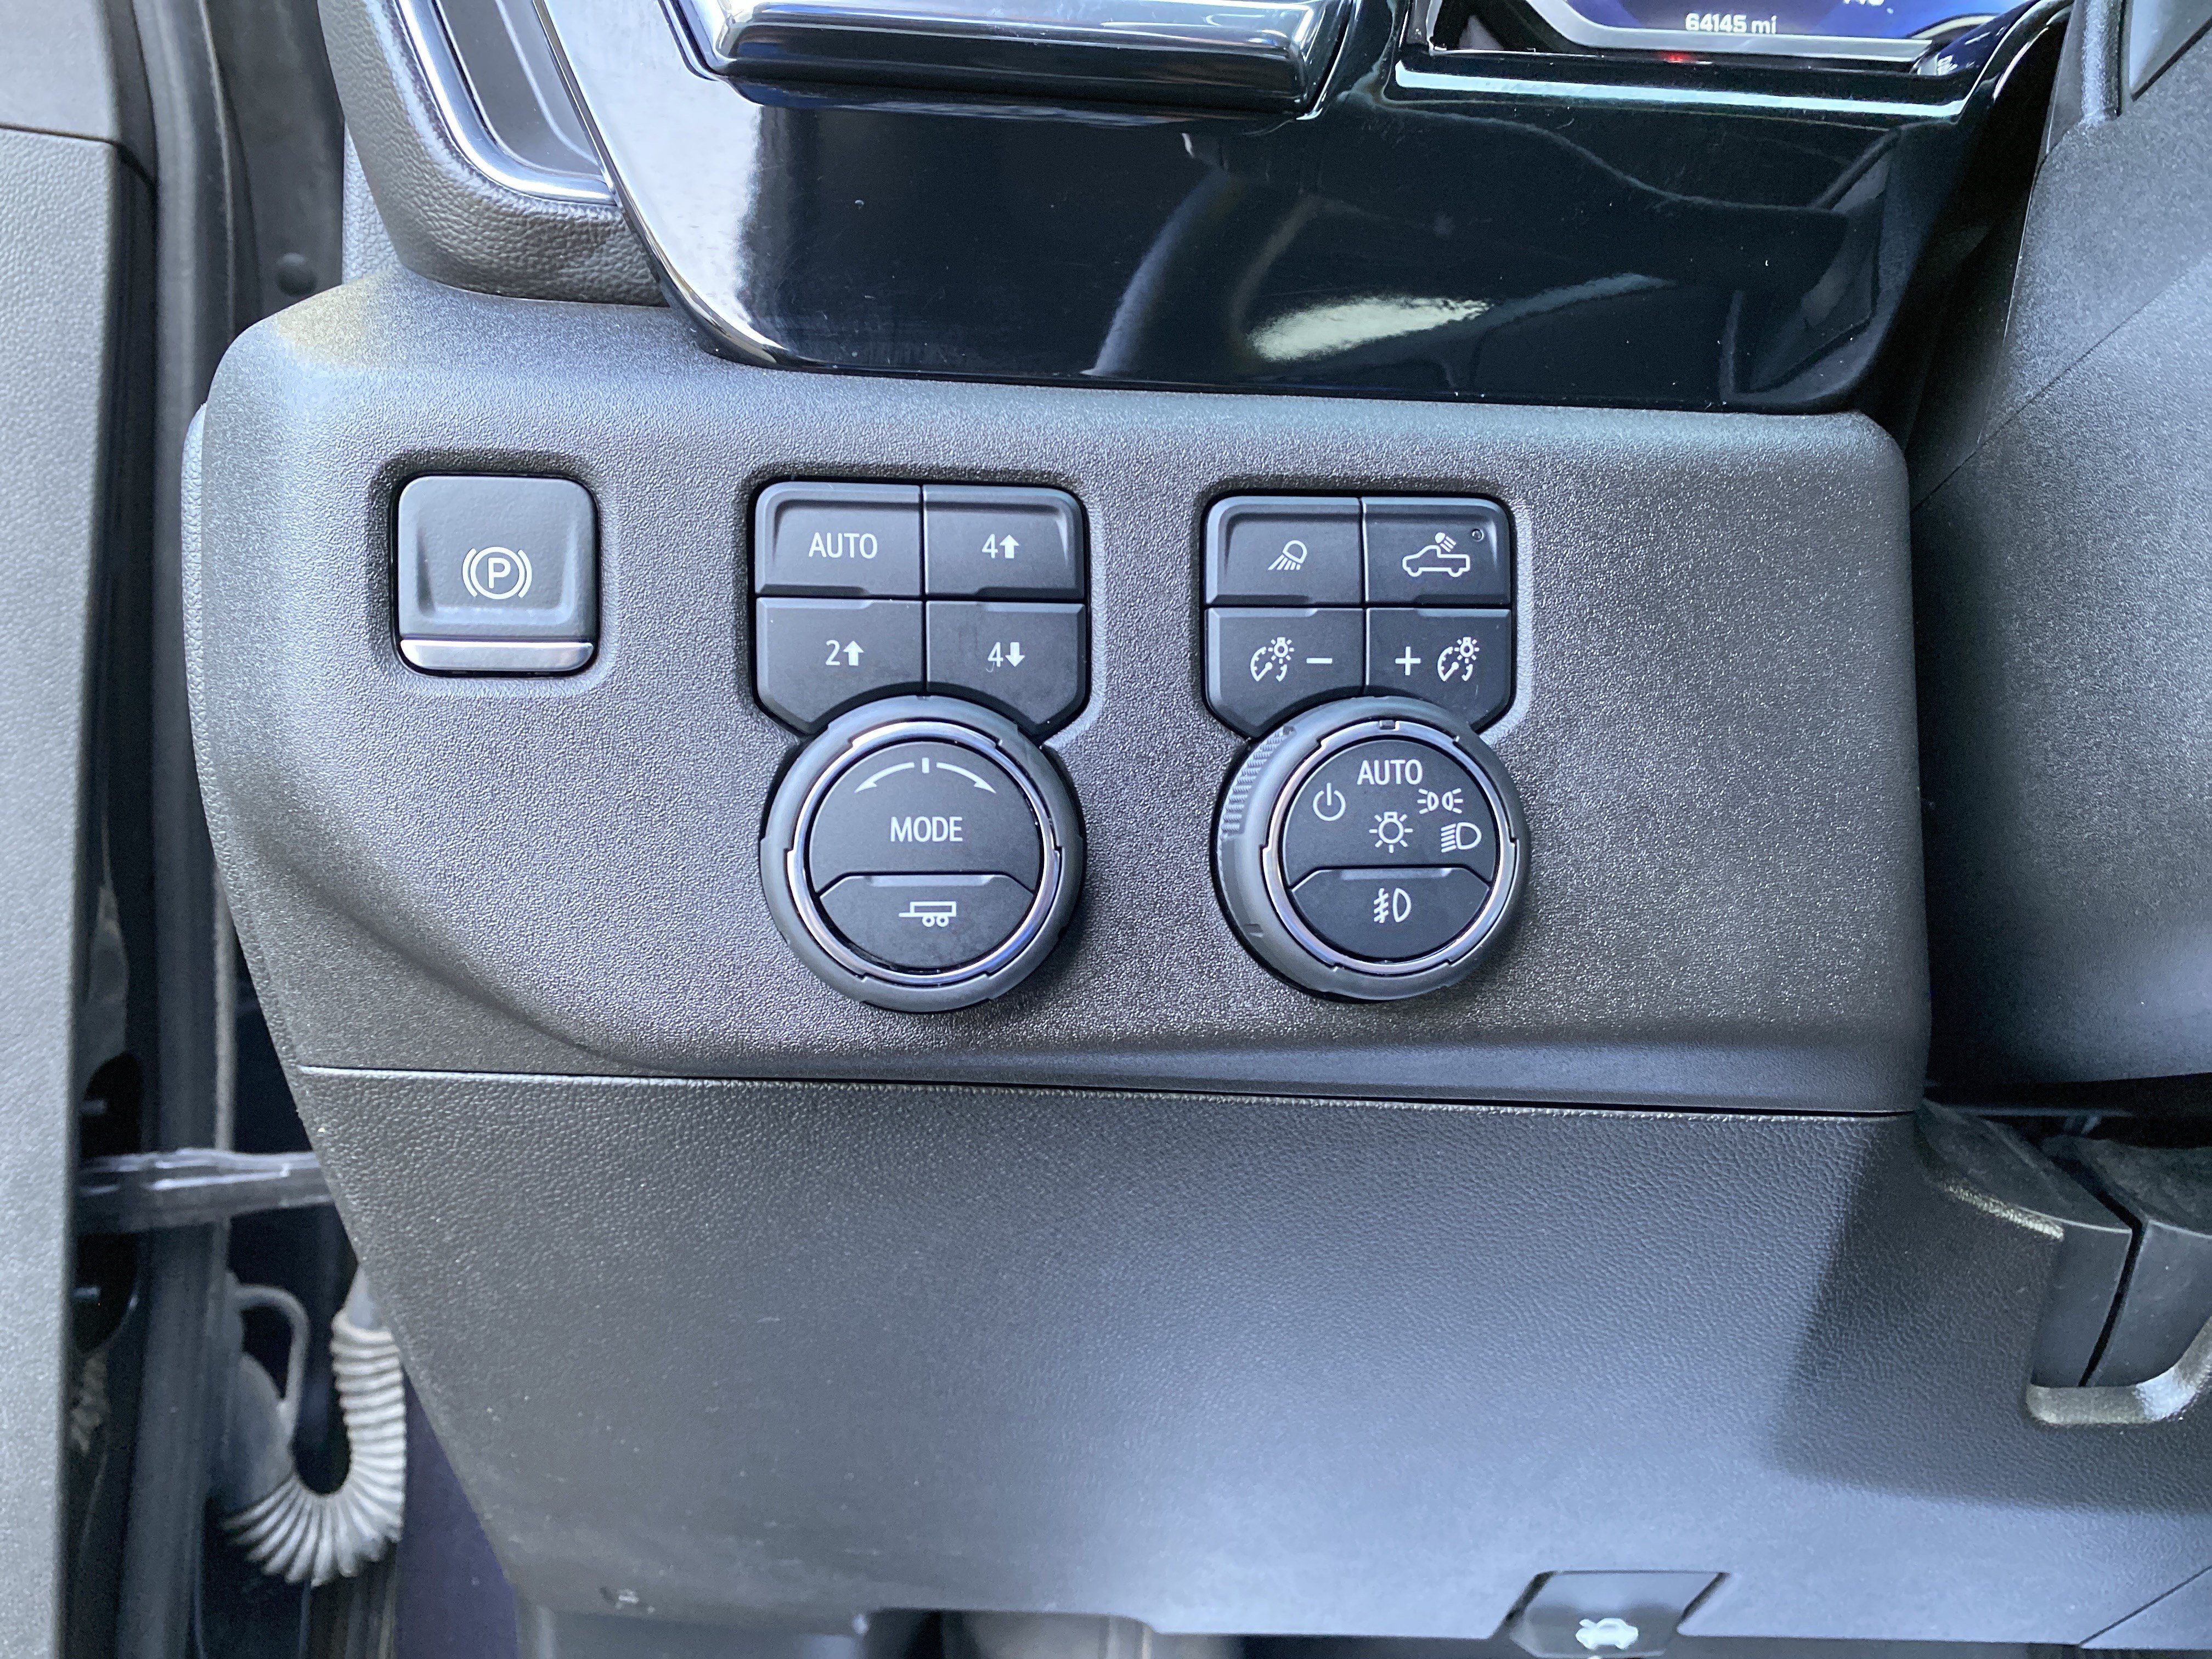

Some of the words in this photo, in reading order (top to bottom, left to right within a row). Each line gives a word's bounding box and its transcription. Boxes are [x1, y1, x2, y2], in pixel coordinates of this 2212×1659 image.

[1685, 13, 1747, 32] 64145
[1752, 15, 1777, 34] mi
[808, 532, 878, 559] AUTO
[982, 533, 998, 558] 4
[488, 557, 511, 589] P
[825, 640, 840, 665] 2
[988, 641, 1004, 667] 4
[1356, 759, 1423, 785] AUTO
[890, 816, 963, 842] MODE
